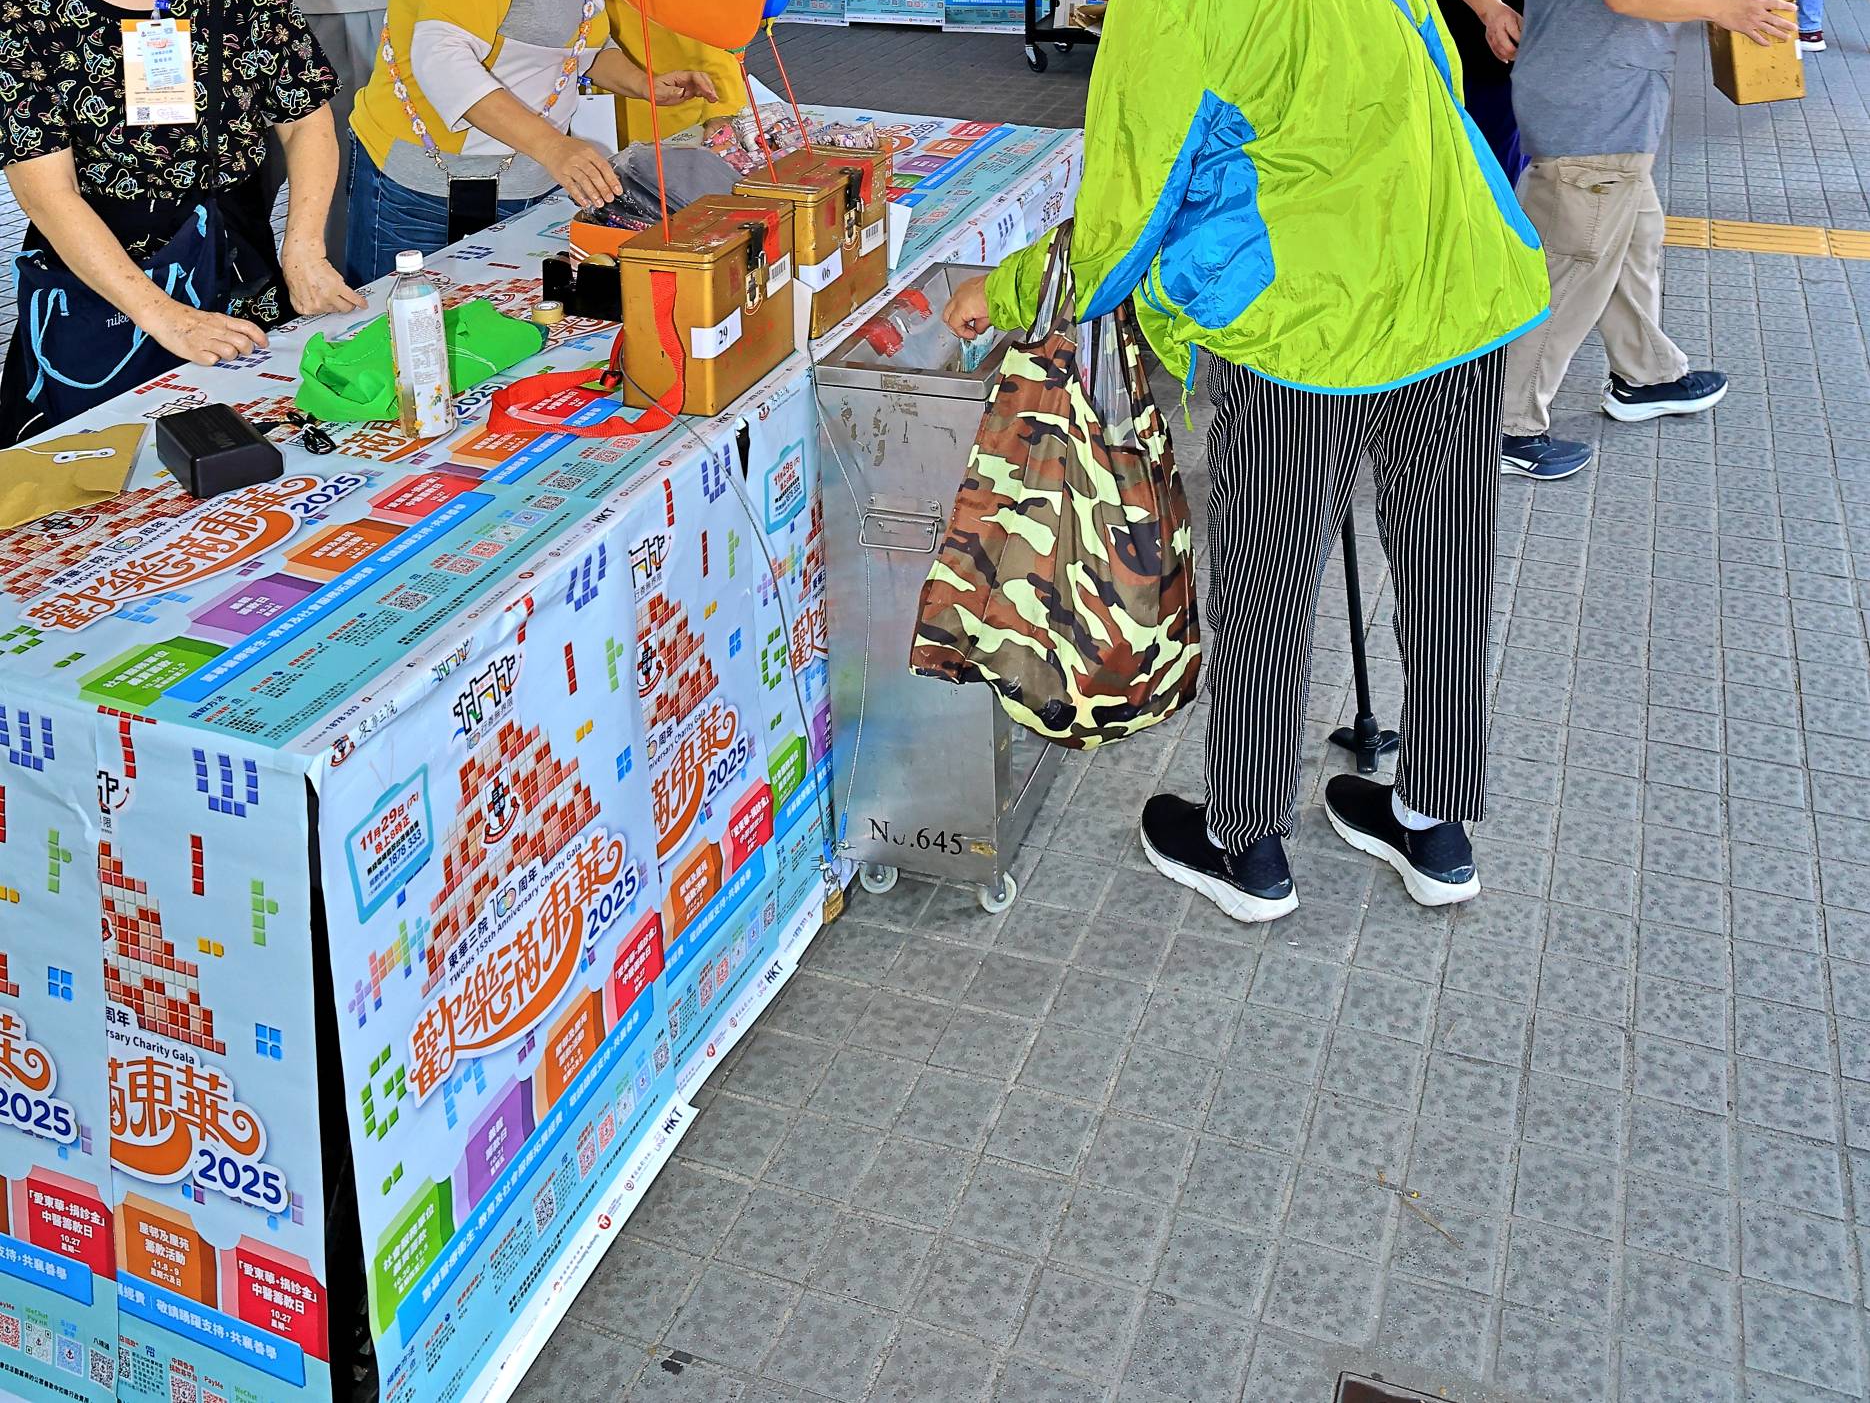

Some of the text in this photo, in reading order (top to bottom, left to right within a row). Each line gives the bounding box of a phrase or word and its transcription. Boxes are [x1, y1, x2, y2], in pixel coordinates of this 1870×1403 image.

[906, 122, 934, 139] 2025
[821, 266, 831, 281] 06
[106, 312, 129, 328] nike
[718, 326, 728, 345] 29
[456, 383, 502, 415] 2025
[289, 474, 362, 515] 2025
[591, 506, 617, 526] HKT
[28, 475, 319, 630] 歡樂滿東華
[50, 552, 111, 587] 東華三院
[141, 519, 169, 537] 周年
[63, 495, 232, 589] TWGHs 155th Anniversary Charity Gala
[326, 705, 361, 730] 1878 333
[674, 708, 707, 745] Charity Gala
[657, 723, 674, 746] 周年
[707, 737, 748, 794] 2025
[360, 803, 405, 852] 11月29日
[374, 813, 411, 855] 晚上8時正
[388, 828, 422, 868] 1878 333
[447, 916, 490, 972] 東華三院
[517, 866, 538, 896] 周年
[448, 841, 583, 986] TWGHs 155th Anniversary Charity Gala
[587, 866, 636, 942] 2025
[410, 835, 624, 1098] 歡樂滿東華
[764, 959, 784, 985] HKT
[106, 1005, 131, 1028] 周年
[132, 1033, 172, 1060] Charity
[172, 1046, 196, 1066] Gala
[0, 1088, 72, 1138] 2025
[662, 1105, 684, 1136] HKT
[198, 1148, 283, 1206] 2025
[41, 1210, 94, 1240] 中醫籌款日
[59, 1234, 82, 1247] 10.27
[60, 1243, 82, 1255] 星期一
[144, 1240, 186, 1266] 籌款活動
[251, 1282, 306, 1315] 中醫籌款日
[270, 1309, 292, 1324] 10.27
[270, 1319, 292, 1333] 星期一
[204, 1374, 224, 1391] PayMe
